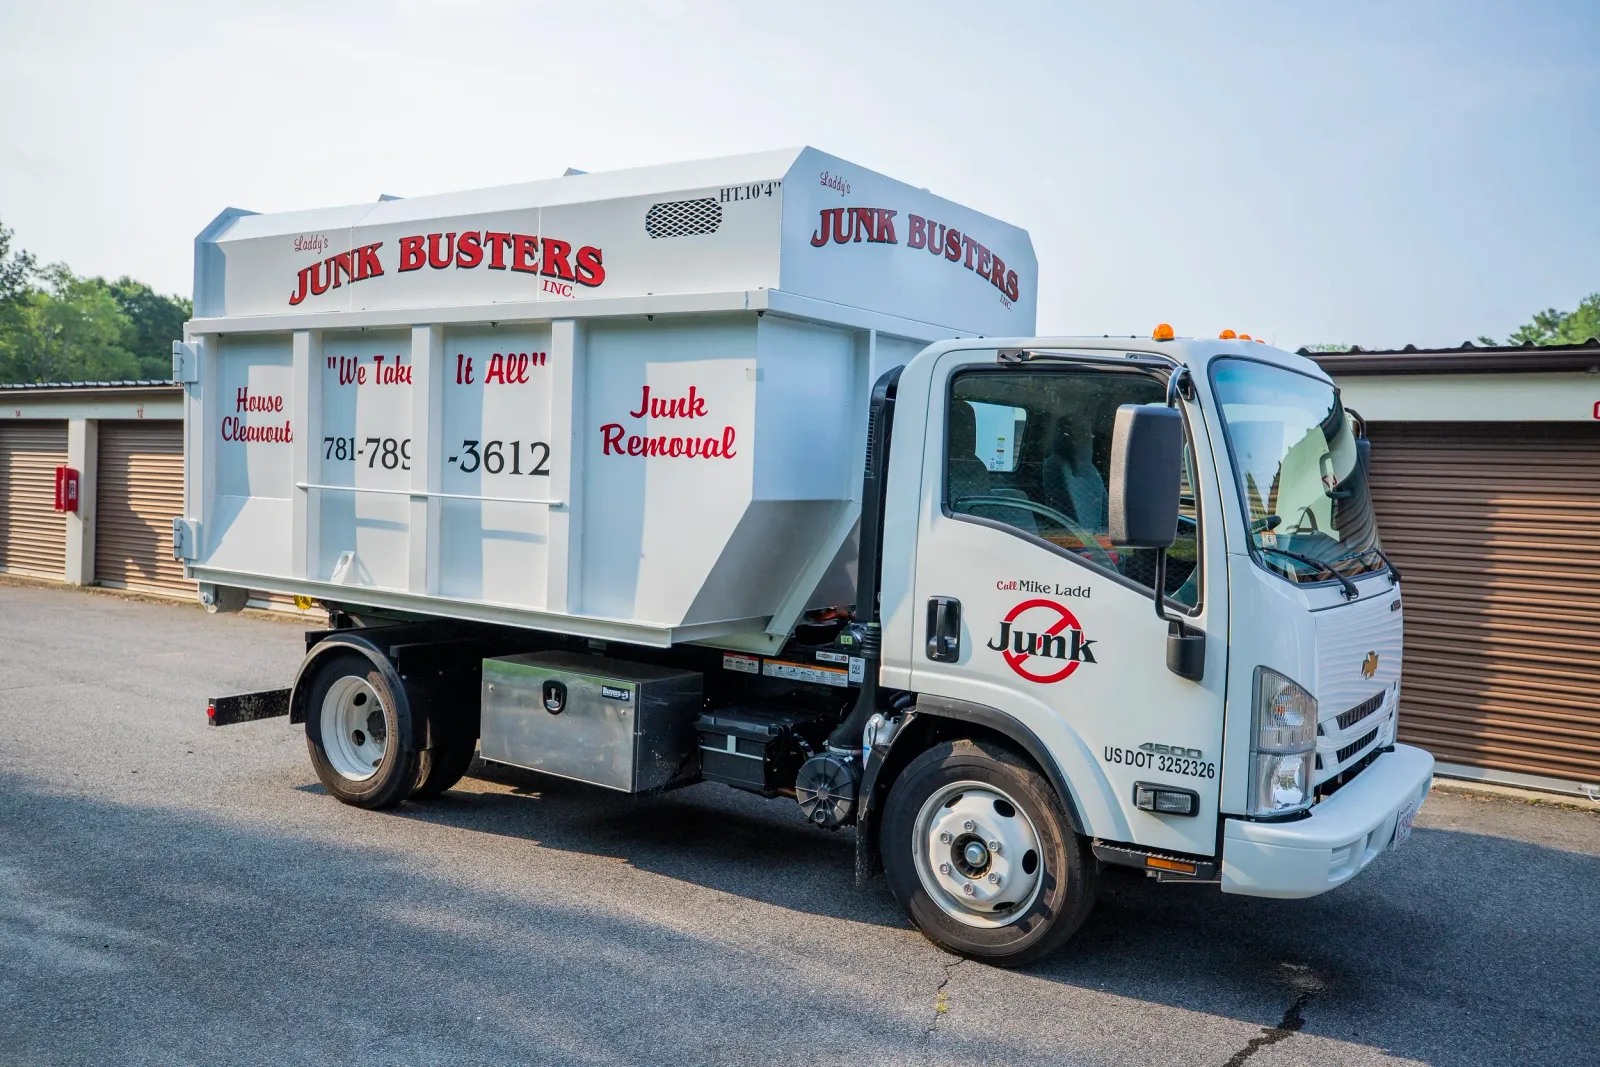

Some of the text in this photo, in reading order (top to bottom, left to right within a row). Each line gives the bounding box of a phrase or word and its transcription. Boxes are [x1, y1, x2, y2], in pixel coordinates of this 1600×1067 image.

[820, 171, 851, 197] Laddy's
[294, 235, 329, 254] Laddy's
[810, 207, 1020, 303] JUNK BUSTERS
[288, 230, 606, 306] JUNK BUSTERS
[542, 279, 576, 299] INC.
[327, 356, 367, 386] "We
[456, 353, 475, 385] It
[484, 352, 547, 385] All"
[236, 387, 284, 413] House
[629, 385, 709, 419] Junk
[599, 423, 737, 459] Removal
[996, 580, 1091, 598] Call Mike Ladd
[986, 621, 1098, 664] Junk
[1104, 746, 1215, 779] US DOT 3252326
[1138, 742, 1203, 760] 4500
